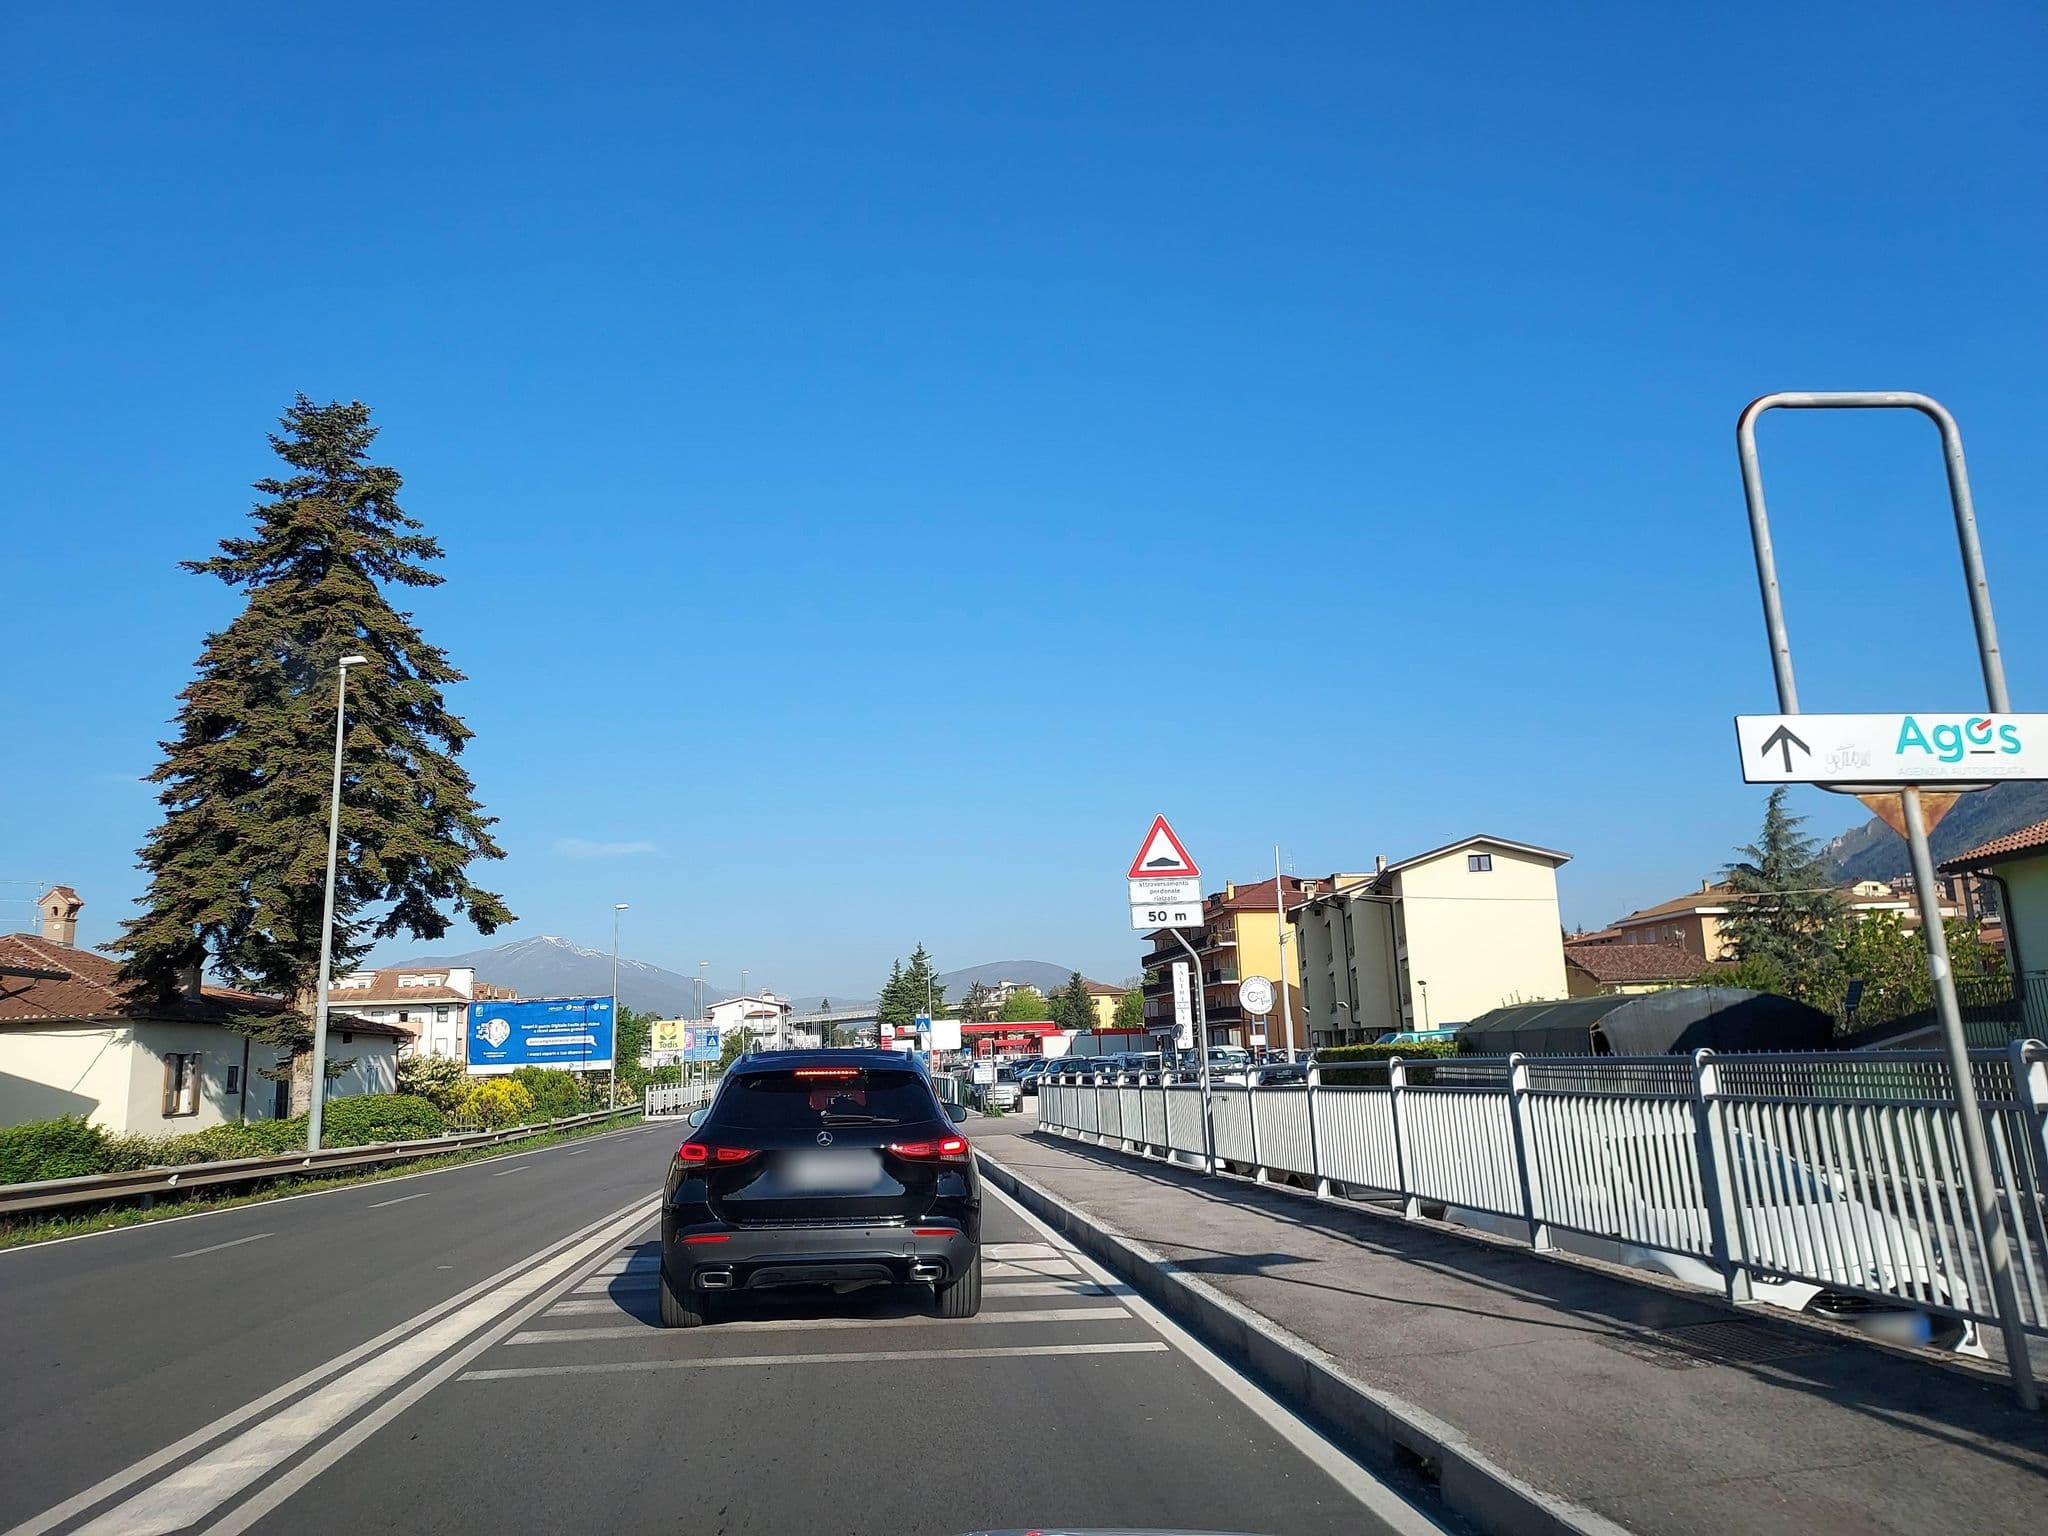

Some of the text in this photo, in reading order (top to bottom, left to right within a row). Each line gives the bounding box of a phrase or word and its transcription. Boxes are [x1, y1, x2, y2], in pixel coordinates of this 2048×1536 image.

[1895, 715, 2021, 763] Agos
[1148, 910, 1187, 922] 50 m
[658, 1041, 679, 1049] Todis
